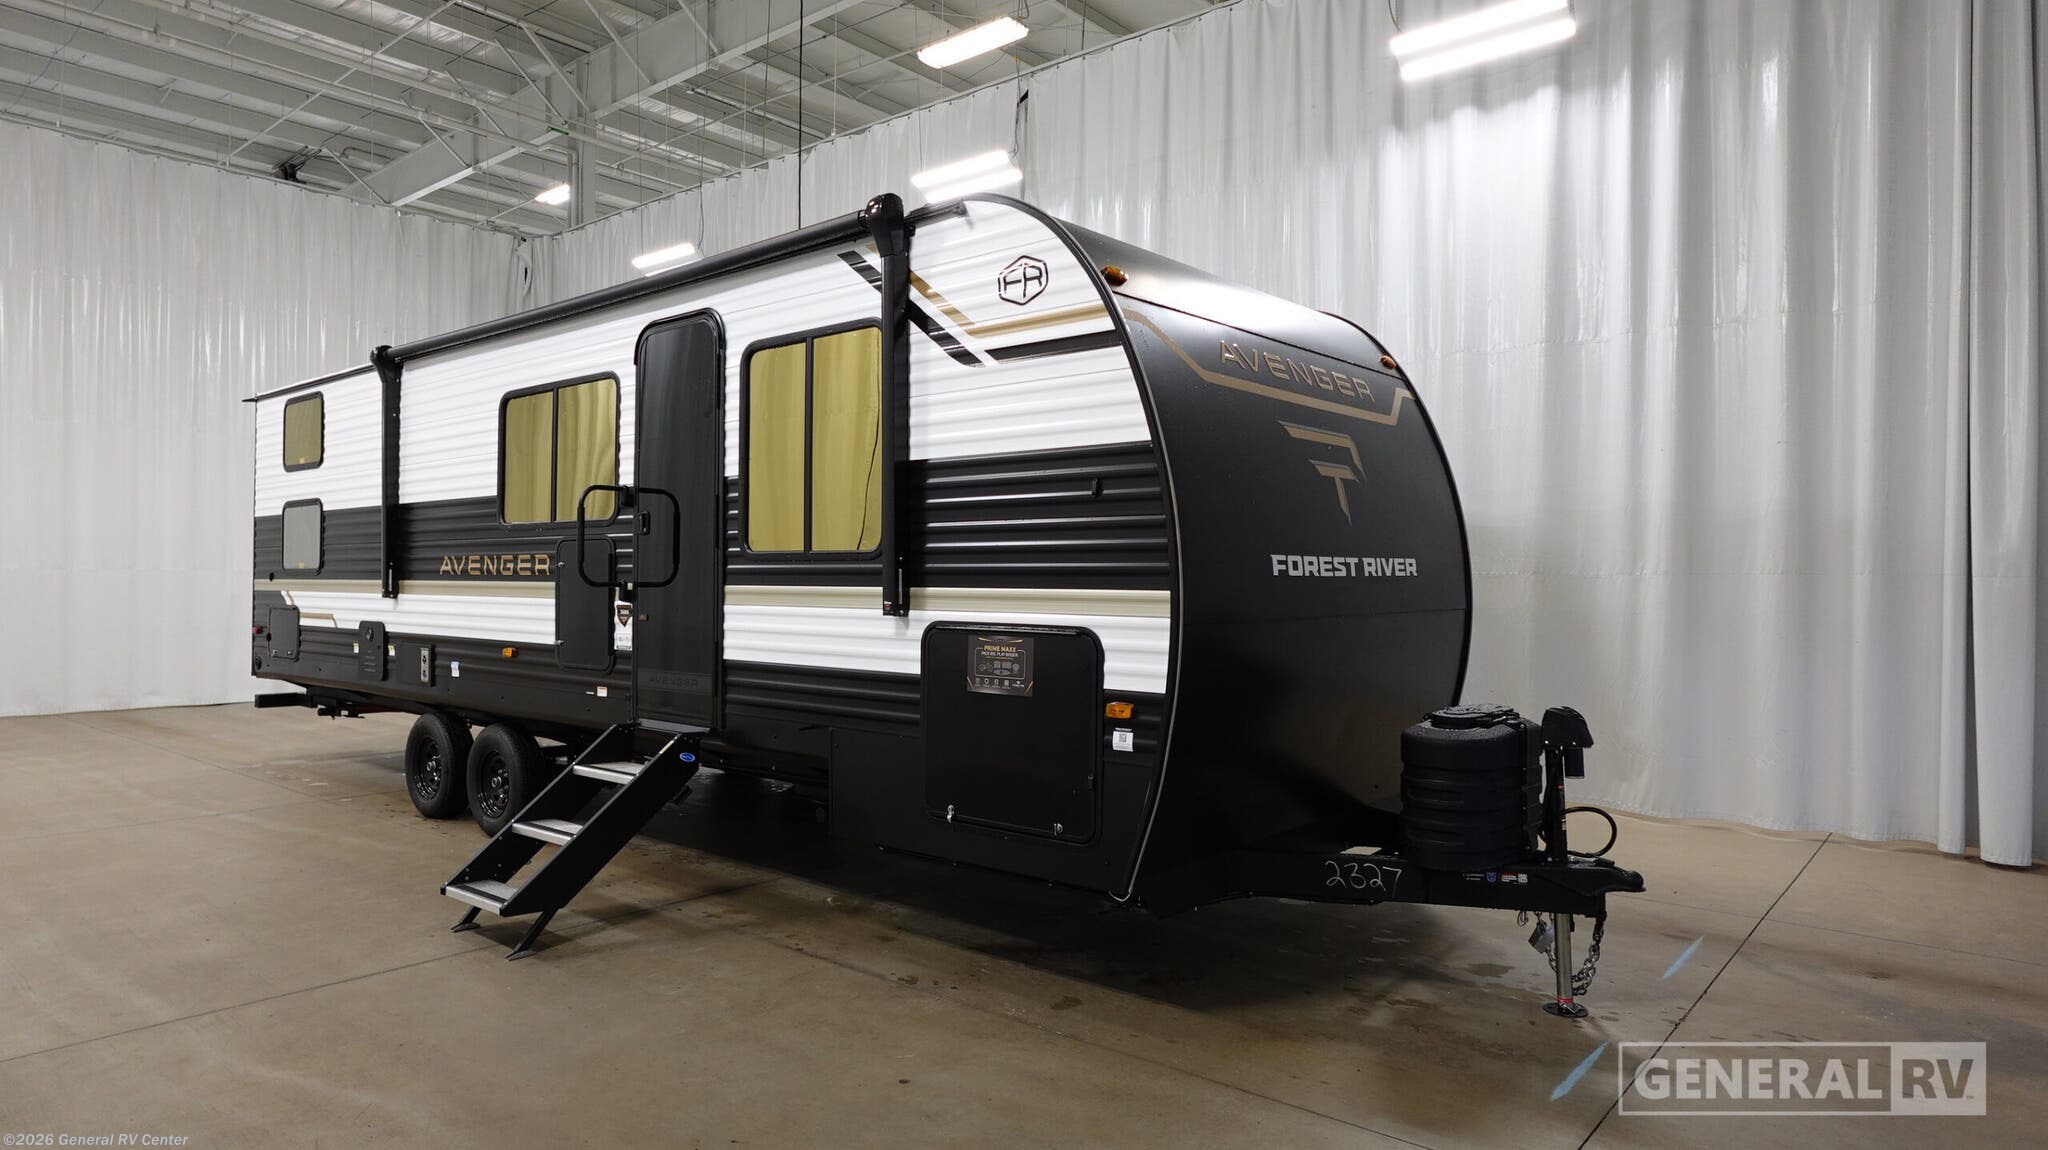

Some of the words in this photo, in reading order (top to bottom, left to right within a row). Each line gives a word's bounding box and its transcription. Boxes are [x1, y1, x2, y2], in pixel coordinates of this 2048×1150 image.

[1219, 339, 1375, 402] AVENGER
[439, 554, 550, 576] AVENGER
[1271, 554, 1358, 577] FOREST
[1362, 557, 1418, 577] RIVER
[1325, 860, 1402, 898] 2327
